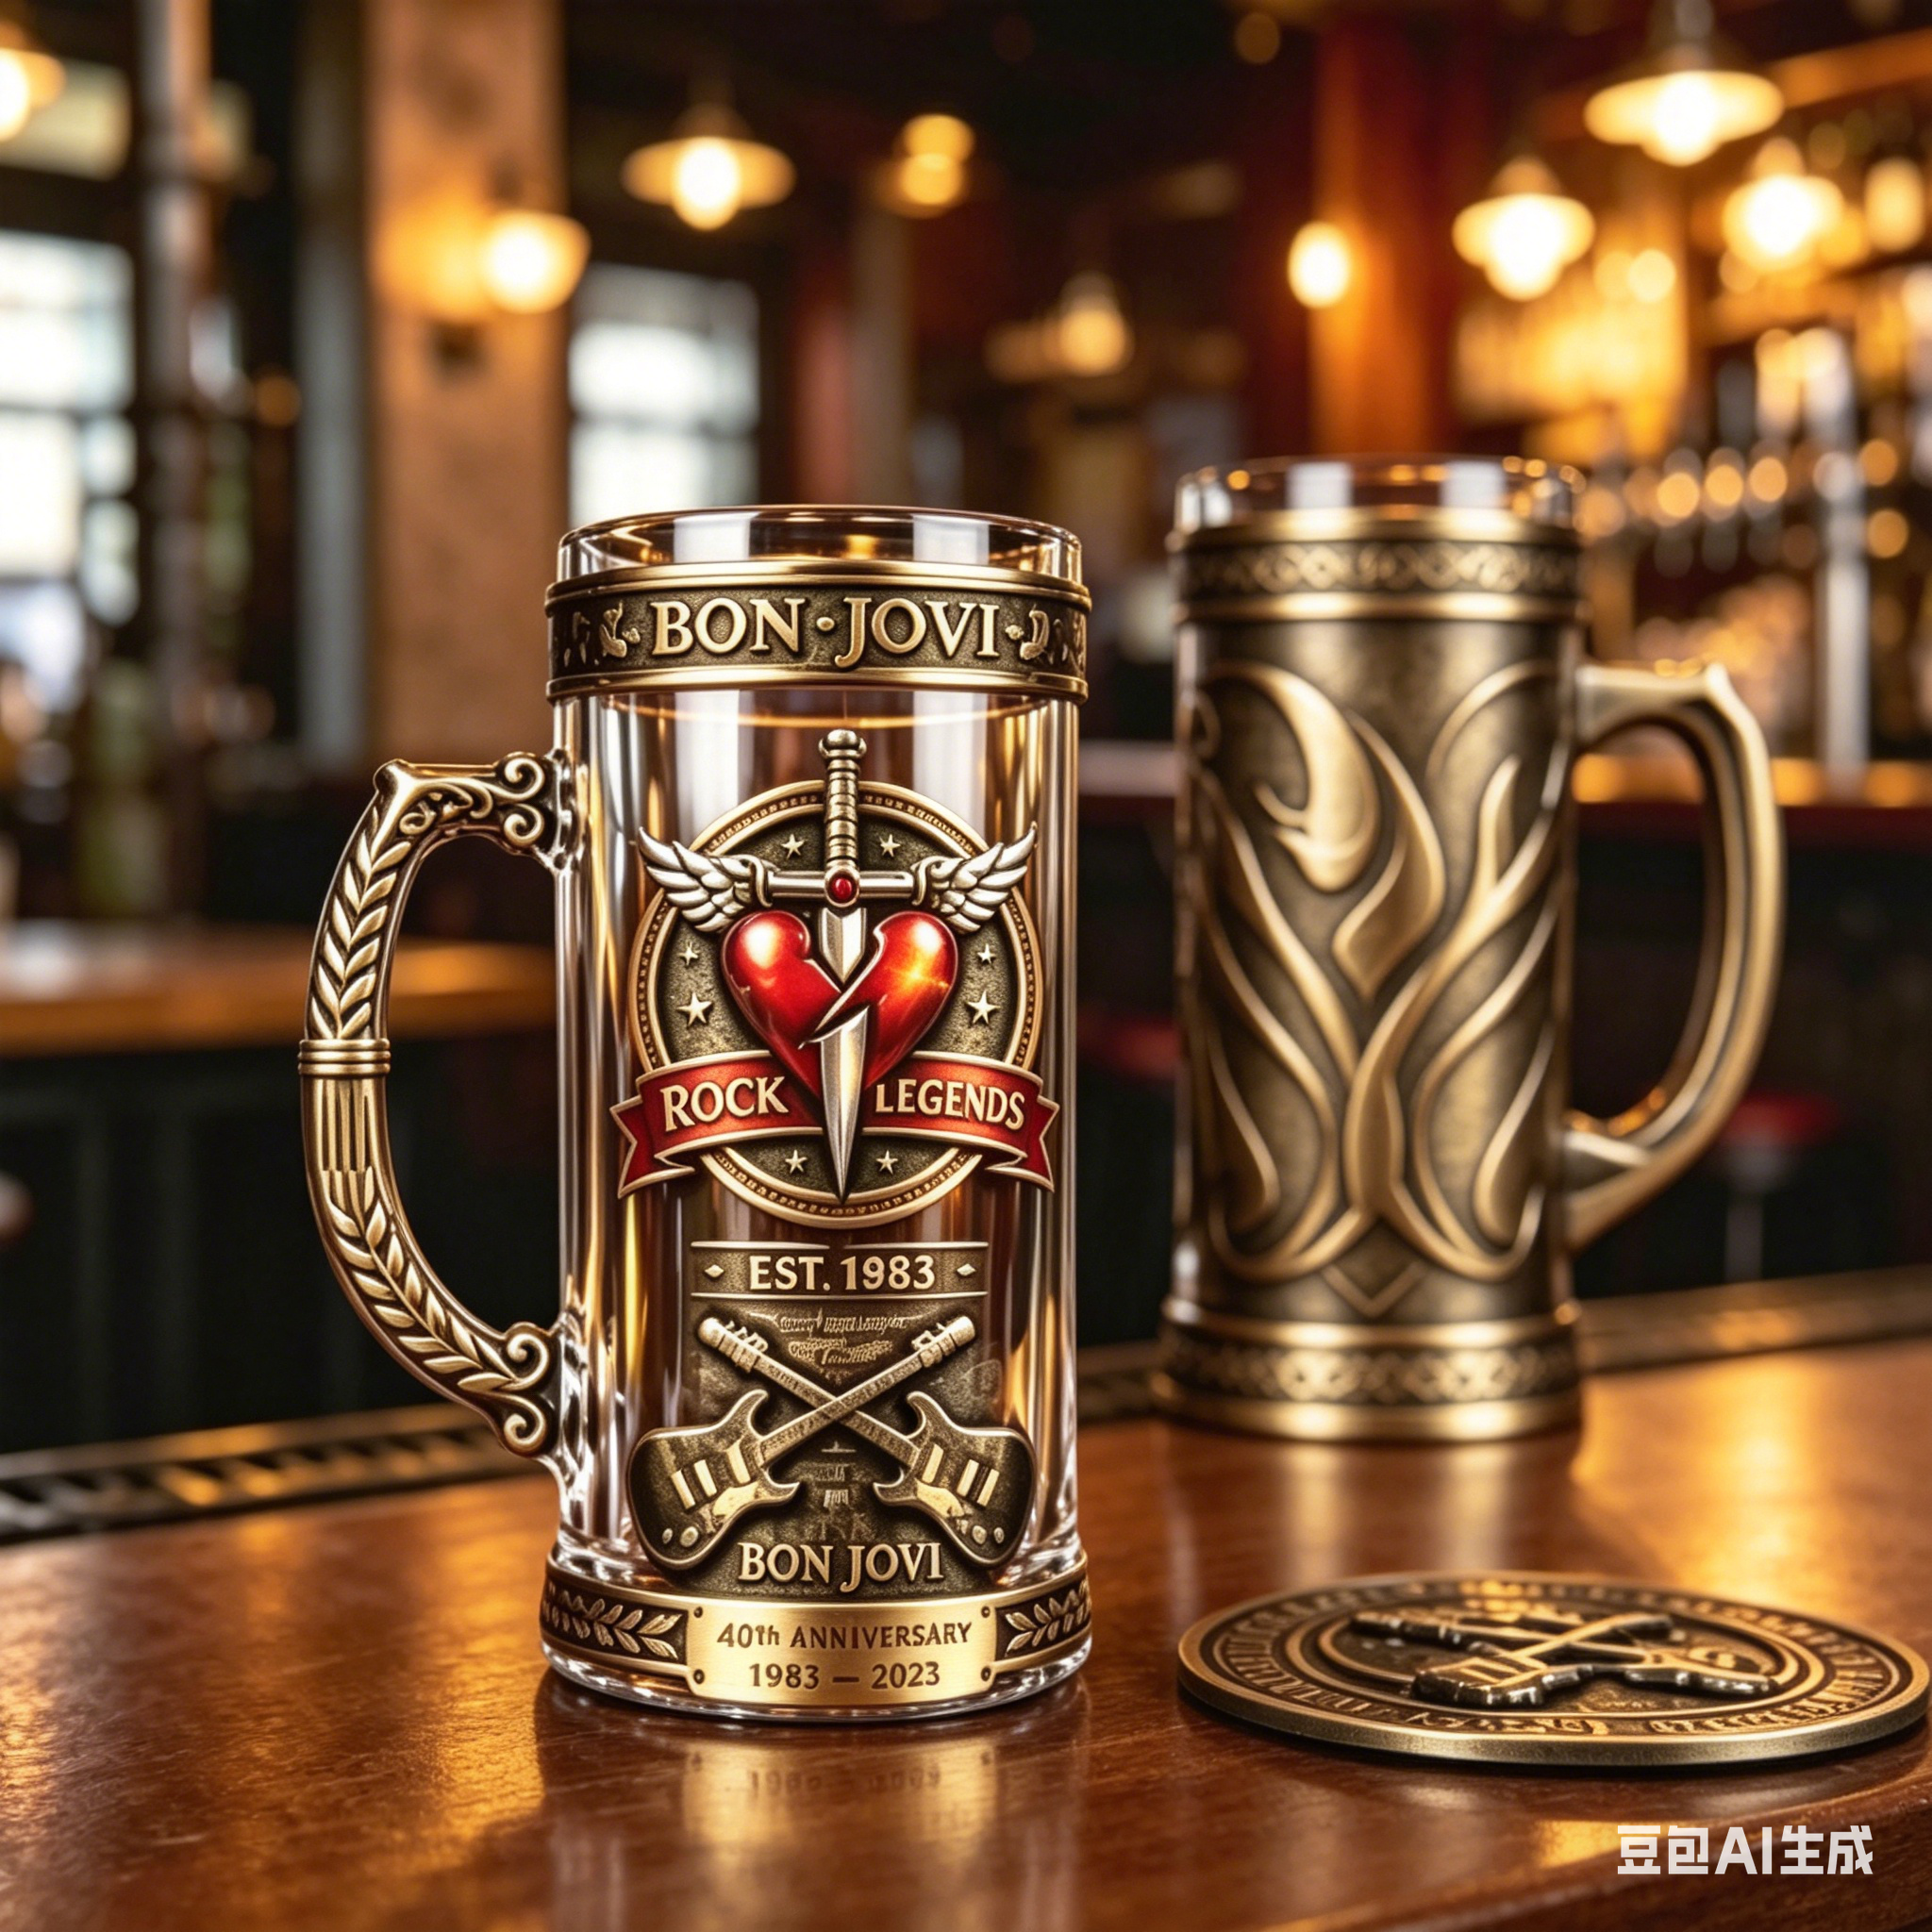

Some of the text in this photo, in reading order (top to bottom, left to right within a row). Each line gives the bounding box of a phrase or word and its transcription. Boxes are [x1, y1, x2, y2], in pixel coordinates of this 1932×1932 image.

[650, 597, 1000, 668] BON JOVI
[660, 1075, 1025, 1132] ROCK LEGENDS
[749, 1255, 936, 1291] EST. 1983
[737, 1542, 943, 1593] BON JOVI
[716, 1622, 973, 1650] 40th ANNIVERSARY
[749, 1663, 820, 1690] 1983
[872, 1661, 941, 1690] 2023
